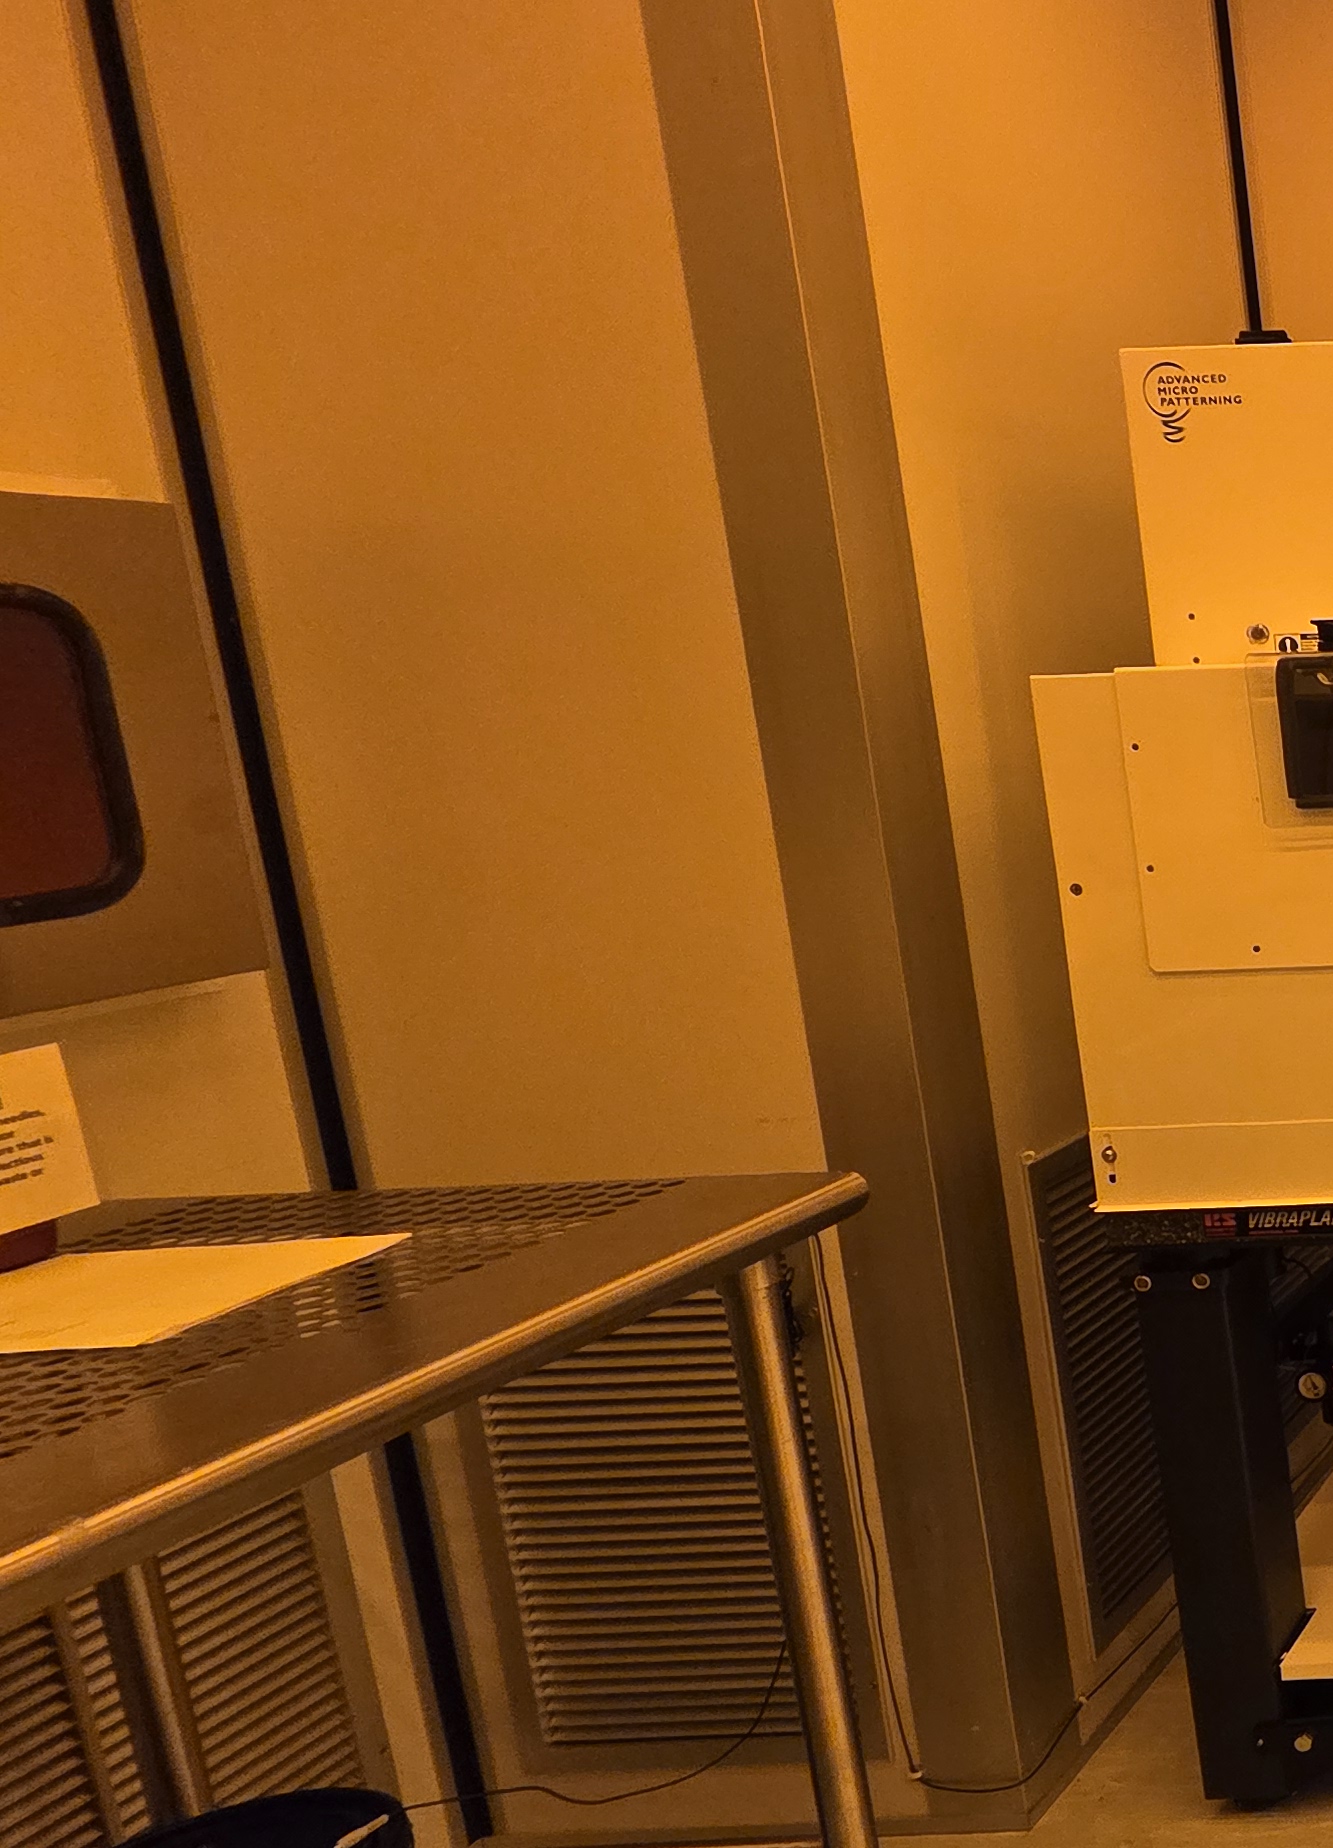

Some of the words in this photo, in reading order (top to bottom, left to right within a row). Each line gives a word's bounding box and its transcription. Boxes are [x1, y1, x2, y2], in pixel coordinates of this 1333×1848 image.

[1157, 373, 1227, 385] ADVANCED
[1157, 386, 1199, 396] MICRO
[1160, 395, 1243, 407] PATTERNING
